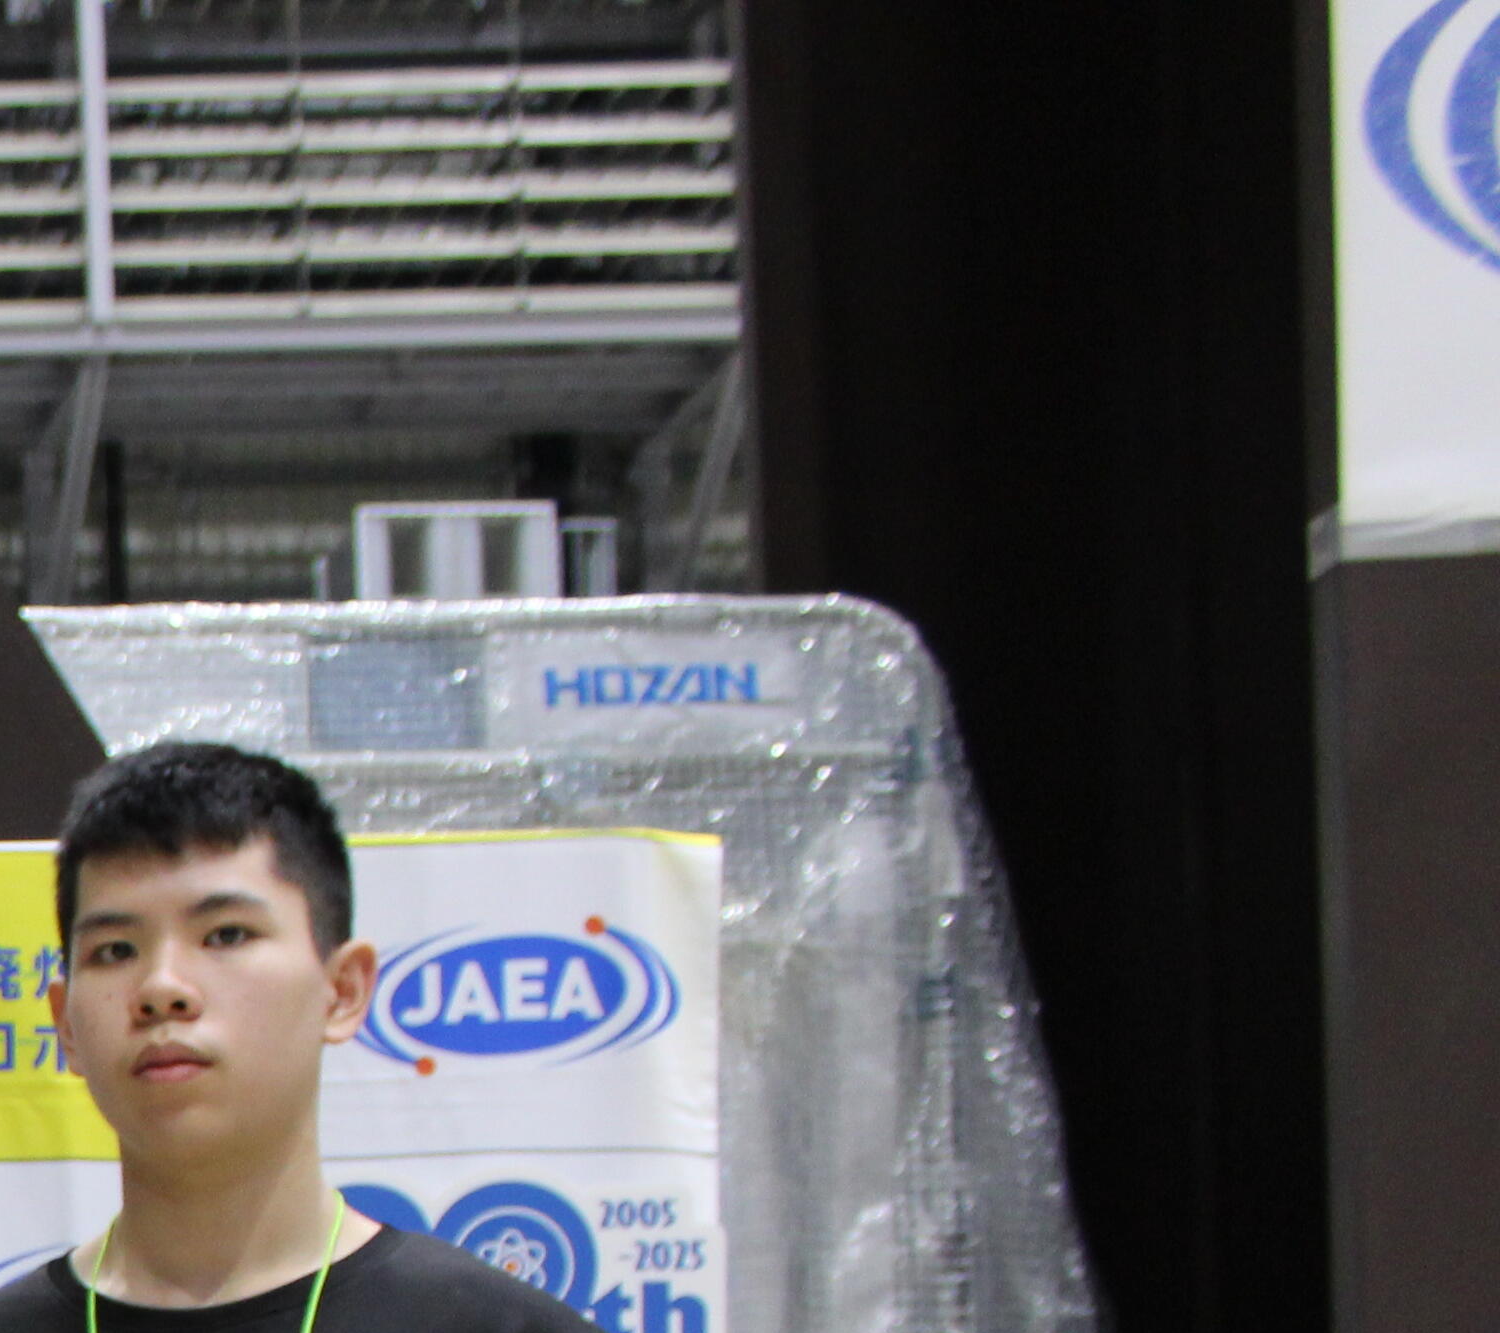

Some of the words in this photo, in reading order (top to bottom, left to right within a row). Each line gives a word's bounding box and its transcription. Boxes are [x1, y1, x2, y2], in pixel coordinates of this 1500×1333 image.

[544, 661, 759, 707] HOZAN
[401, 956, 605, 1027] JAEA
[601, 1199, 678, 1228] 2005
